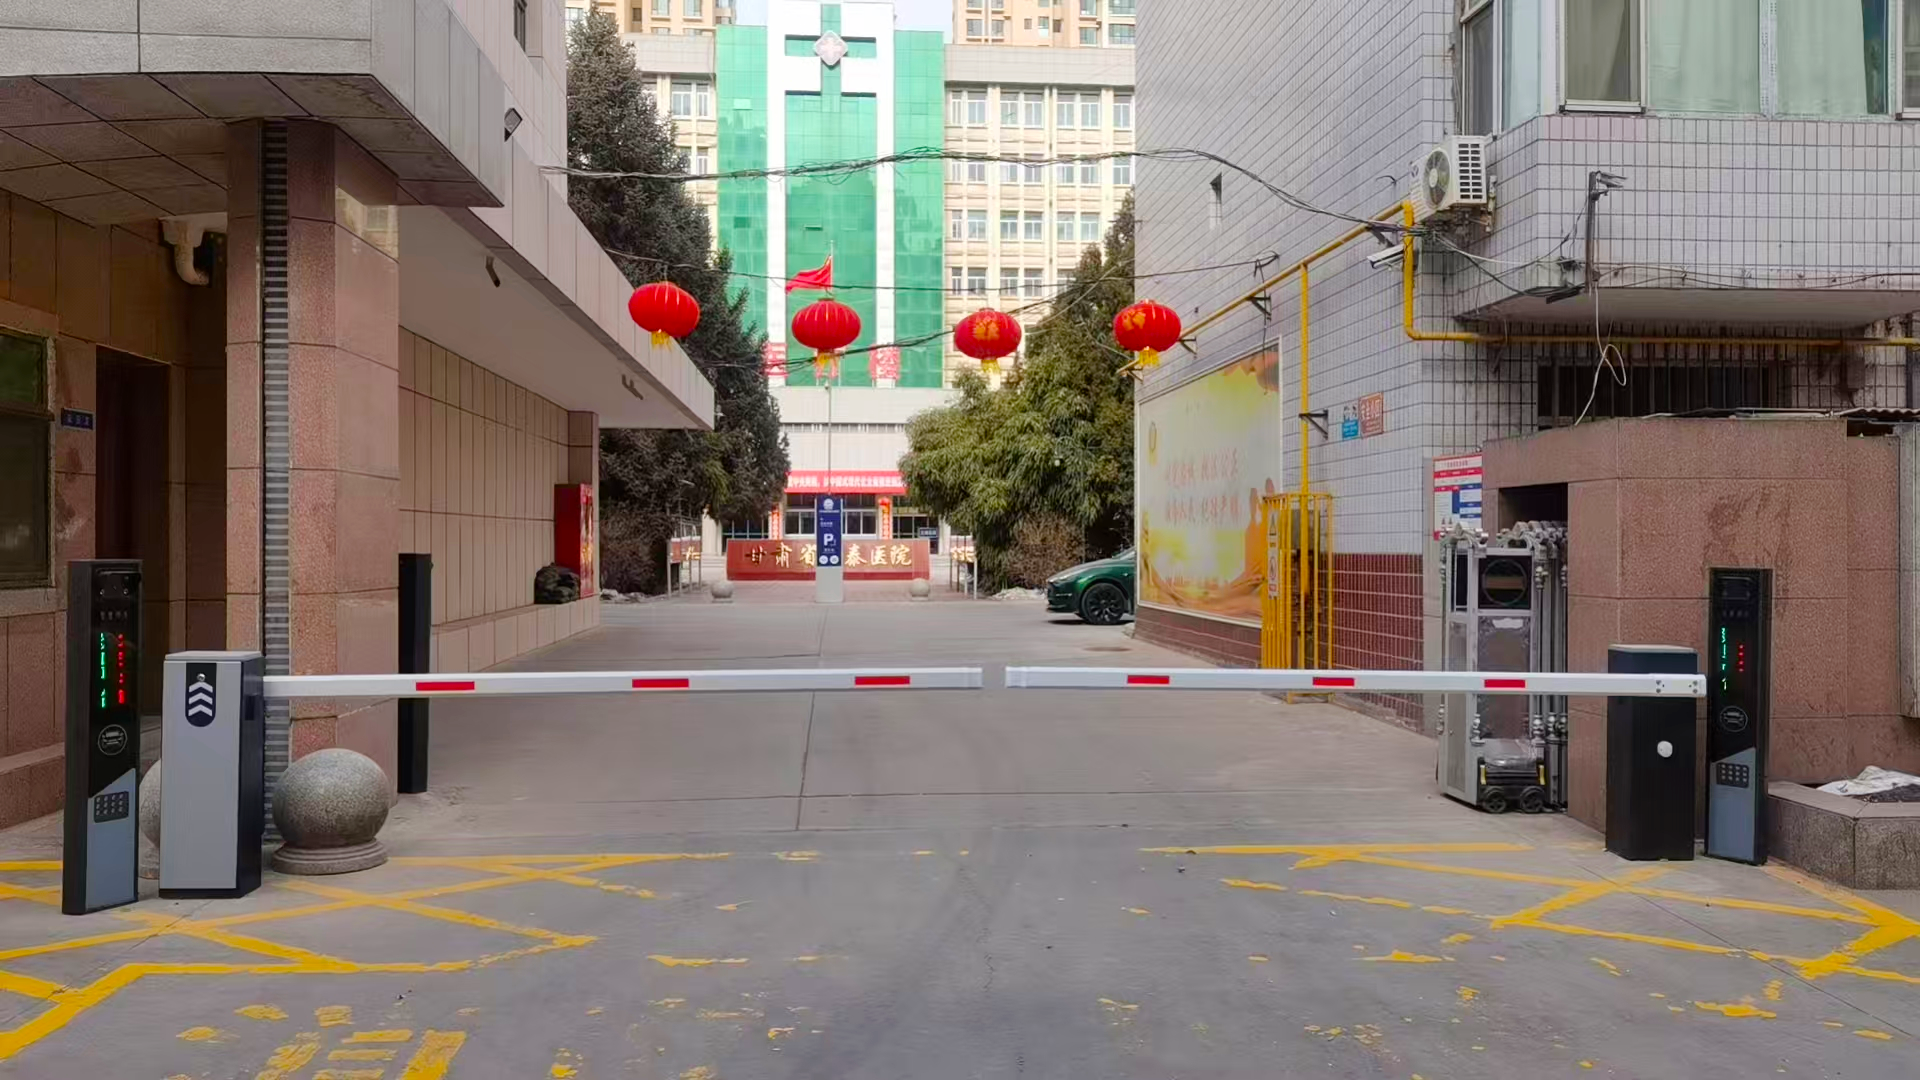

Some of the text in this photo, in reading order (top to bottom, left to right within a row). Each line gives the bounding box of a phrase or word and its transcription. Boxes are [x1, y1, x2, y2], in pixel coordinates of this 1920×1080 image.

[823, 533, 834, 546] P
[745, 542, 912, 568] 甘肃省泰医院
